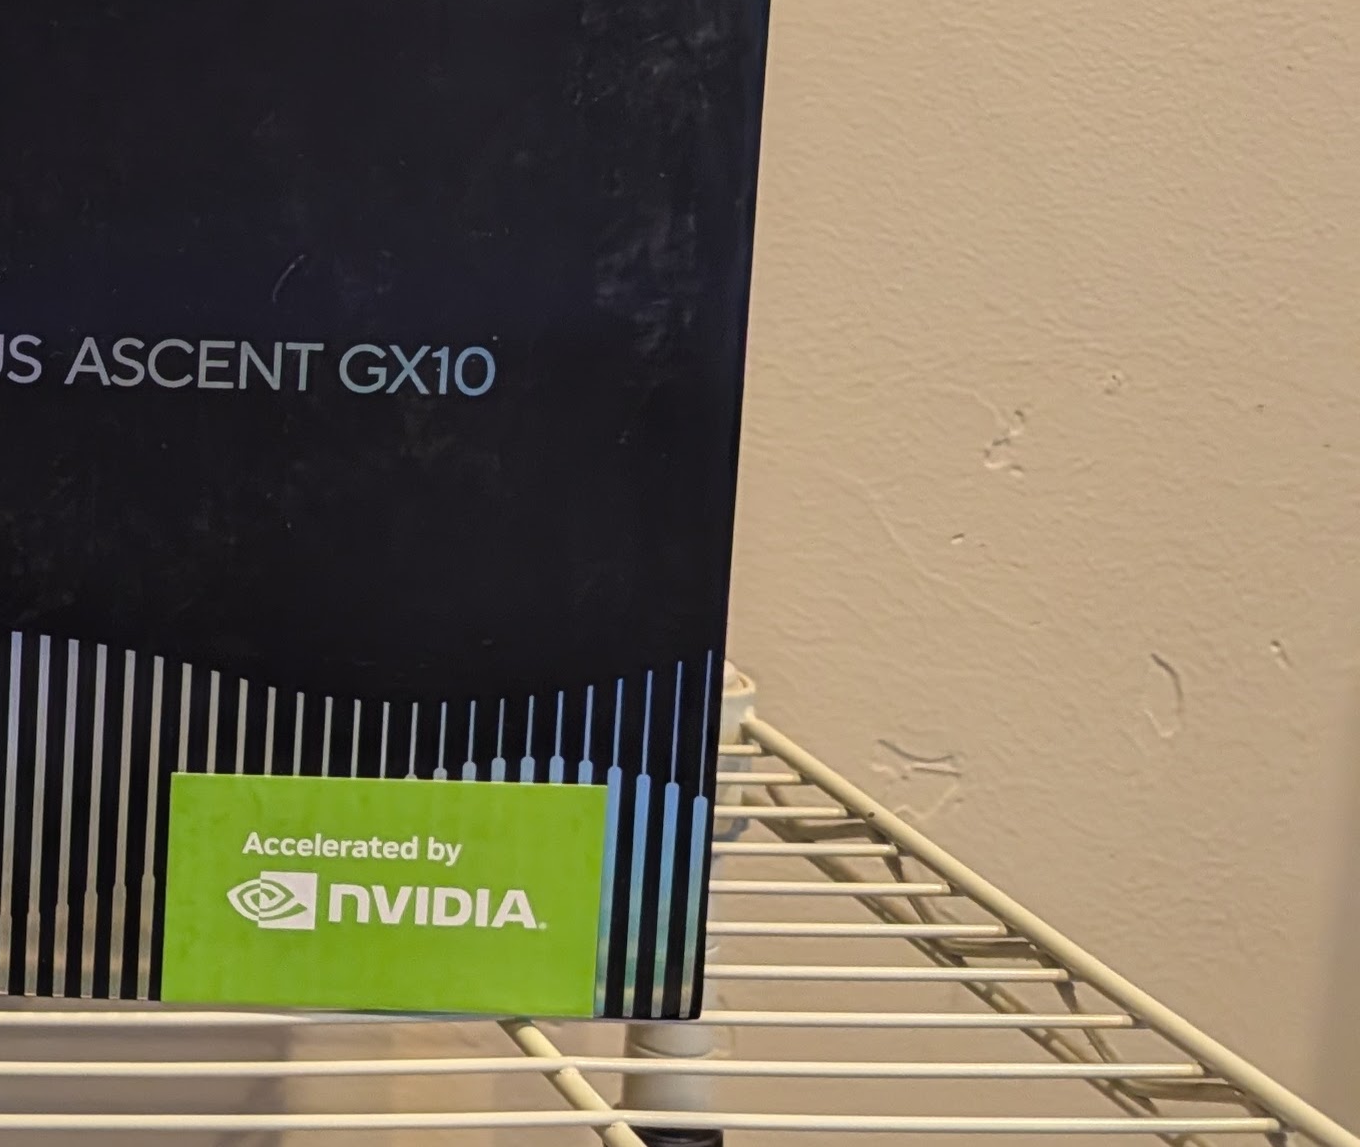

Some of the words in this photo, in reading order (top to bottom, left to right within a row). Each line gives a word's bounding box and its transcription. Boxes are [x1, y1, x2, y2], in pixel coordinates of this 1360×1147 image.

[63, 336, 325, 391] ASCENT
[338, 343, 497, 397] GX10
[242, 831, 419, 860] Accelerated
[427, 835, 463, 866] by
